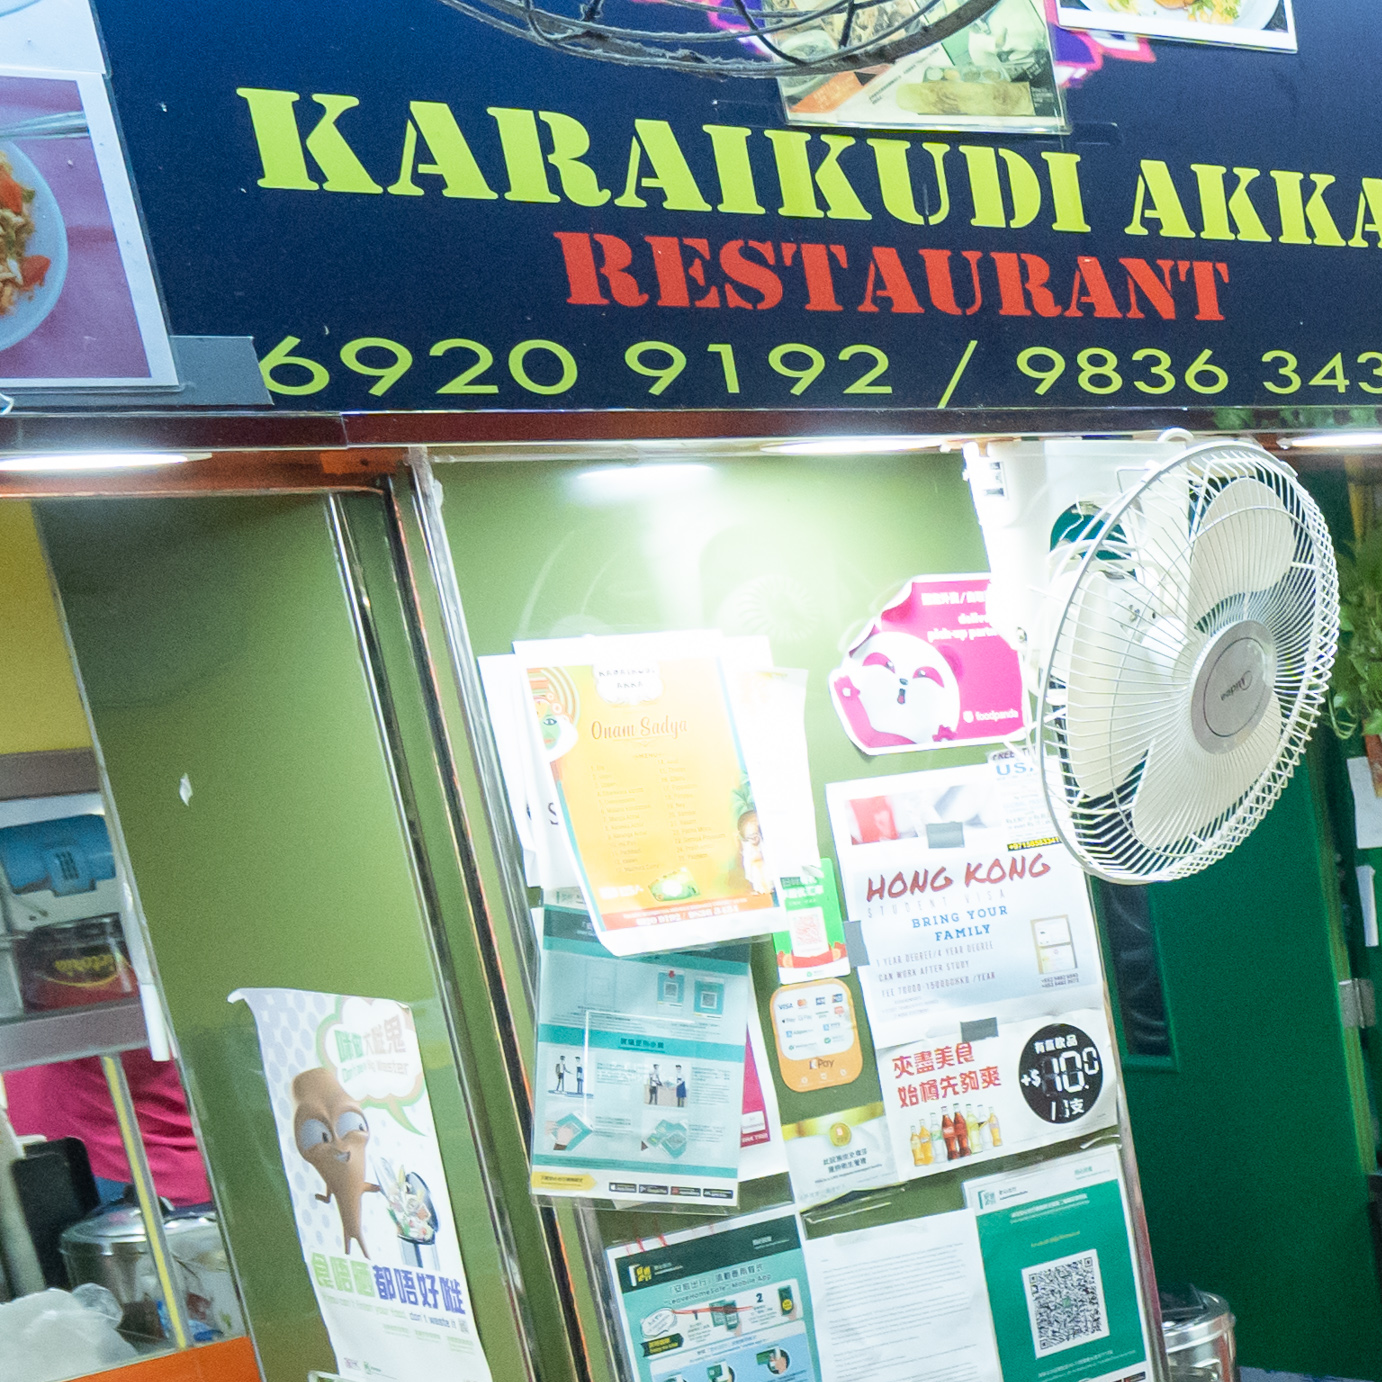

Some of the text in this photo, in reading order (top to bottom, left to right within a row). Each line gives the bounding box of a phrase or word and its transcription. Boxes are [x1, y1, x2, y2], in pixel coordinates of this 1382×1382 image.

[235, 87, 1093, 234] KARAIKUDI
[553, 231, 1230, 321] RESTAURANT
[261, 335, 579, 396] 6920
[624, 340, 893, 396] 9192
[935, 340, 979, 409] /
[1016, 346, 1229, 395] 9836
[591, 715, 688, 740] Onam Sadya
[975, 708, 1019, 722] foodpanda
[996, 762, 1034, 776] US
[866, 853, 1051, 902] HONG KONG
[867, 888, 1006, 919] STUDENT VISA
[912, 905, 1008, 929] BRING YOUR
[935, 924, 991, 942] FAMILY
[884, 955, 902, 967] YEAR
[945, 945, 964, 957] YEAR
[966, 940, 994, 954] DEGREE
[878, 960, 970, 983] CAN WORK AFTER STUDY
[777, 1002, 794, 1011] VISA
[892, 1042, 976, 1079] 夾盡美食
[898, 1065, 1002, 1109] 始樽先夠爽
[756, 1293, 764, 1303] 2
